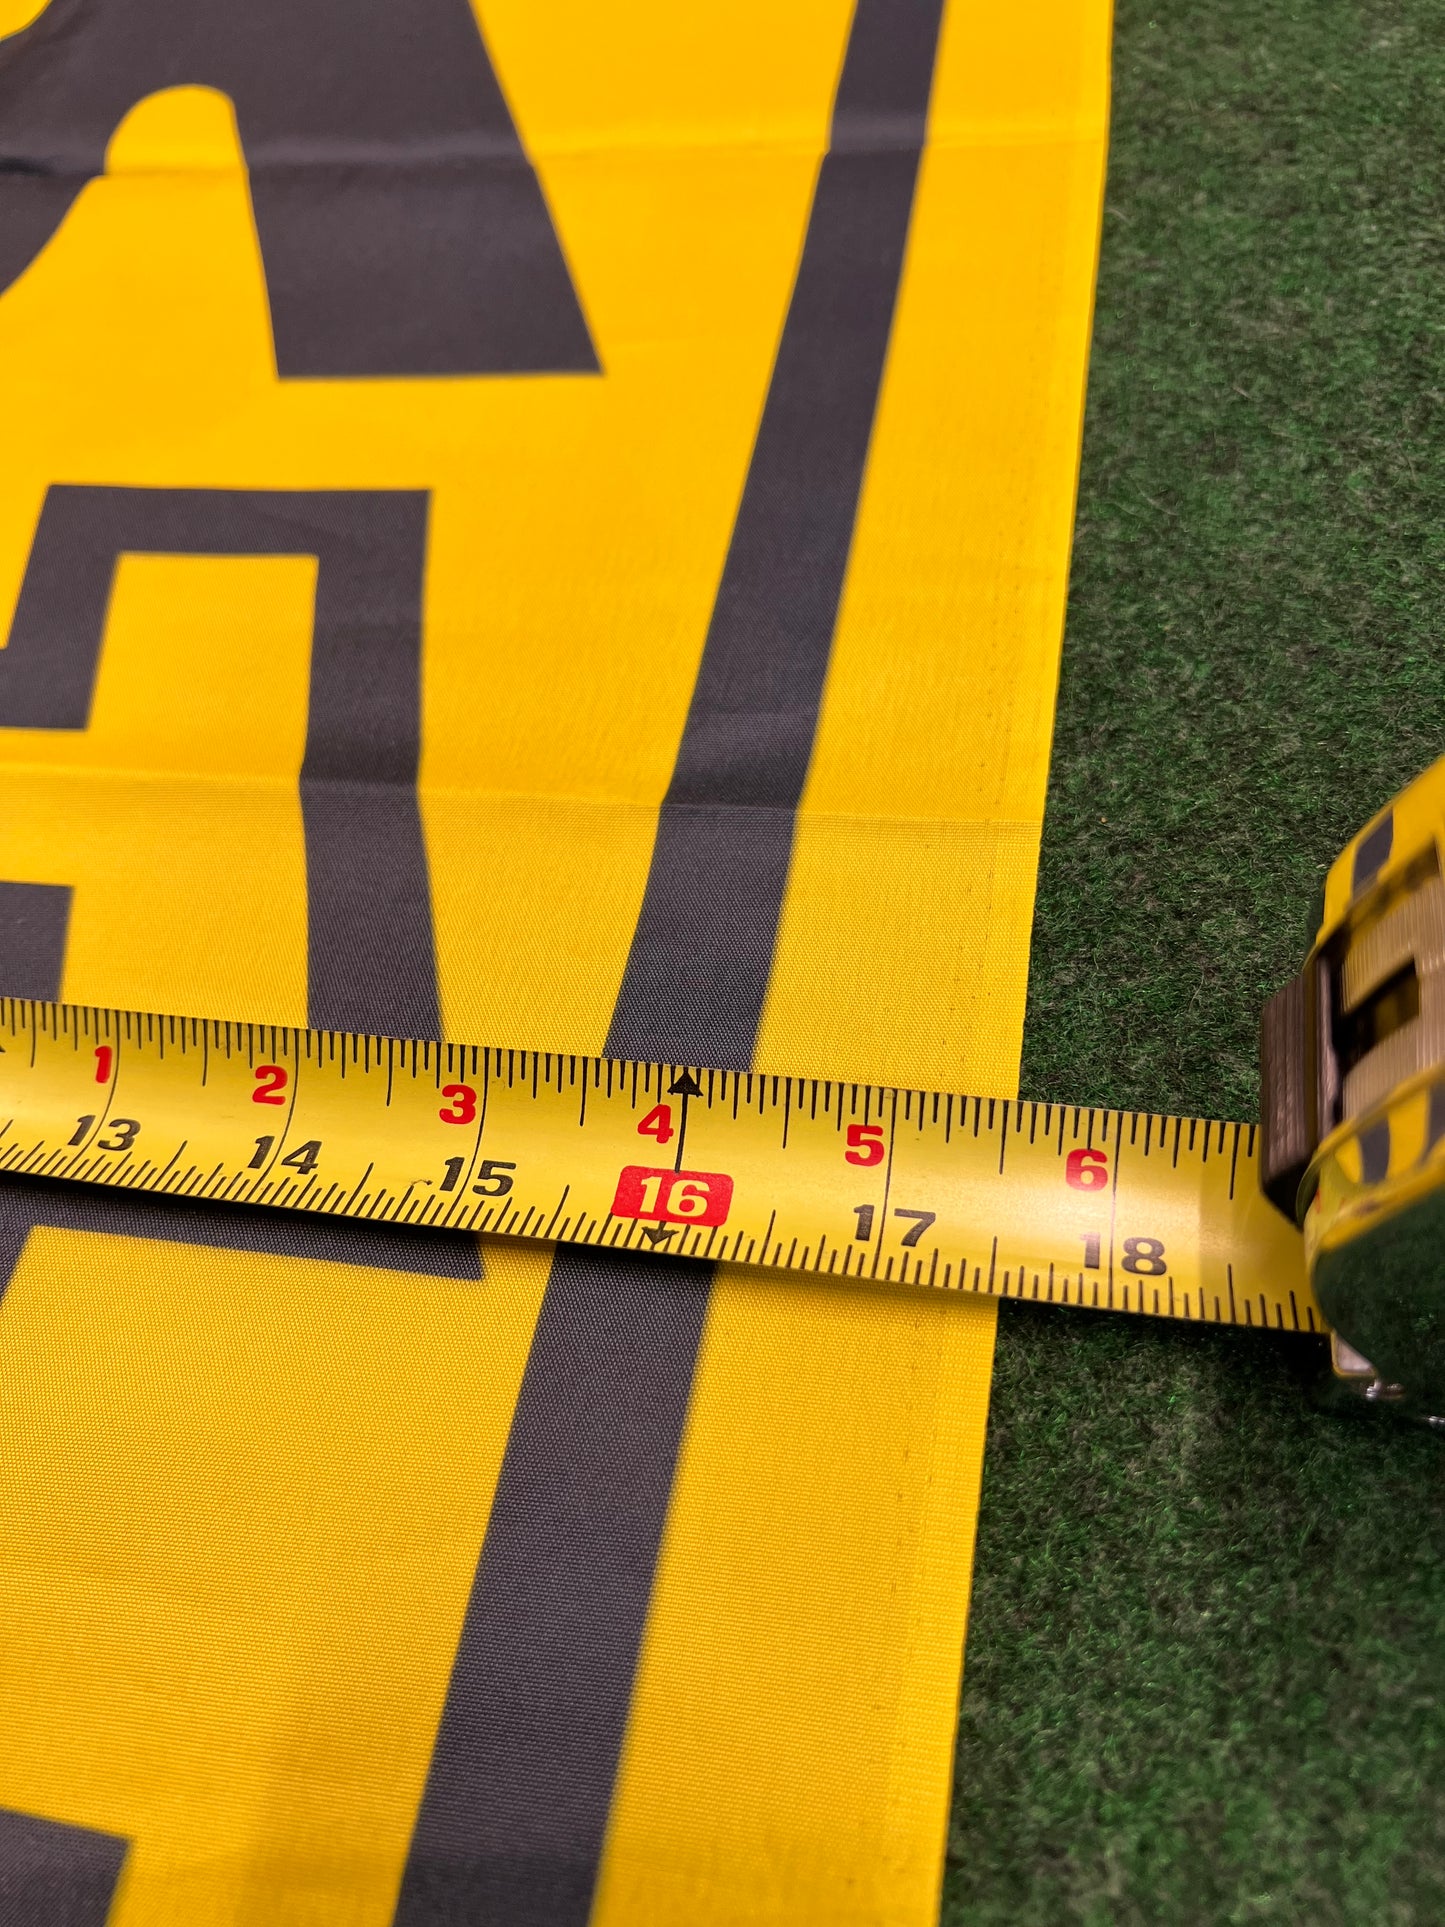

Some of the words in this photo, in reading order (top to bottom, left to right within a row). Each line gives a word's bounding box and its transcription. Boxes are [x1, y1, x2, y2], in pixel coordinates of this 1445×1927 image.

[67, 1114, 141, 1151] 13
[247, 1135, 323, 1175] 14
[439, 1156, 517, 1197] 15
[639, 1176, 711, 1217] 16
[853, 1204, 937, 1247] 17
[1080, 1232, 1168, 1276] 18
[95, 1045, 113, 1083] 1
[252, 1065, 288, 1105] 2
[438, 1084, 477, 1124] 3
[637, 1104, 674, 1144] 4
[844, 1124, 885, 1167] 5
[1065, 1148, 1109, 1191] 6
